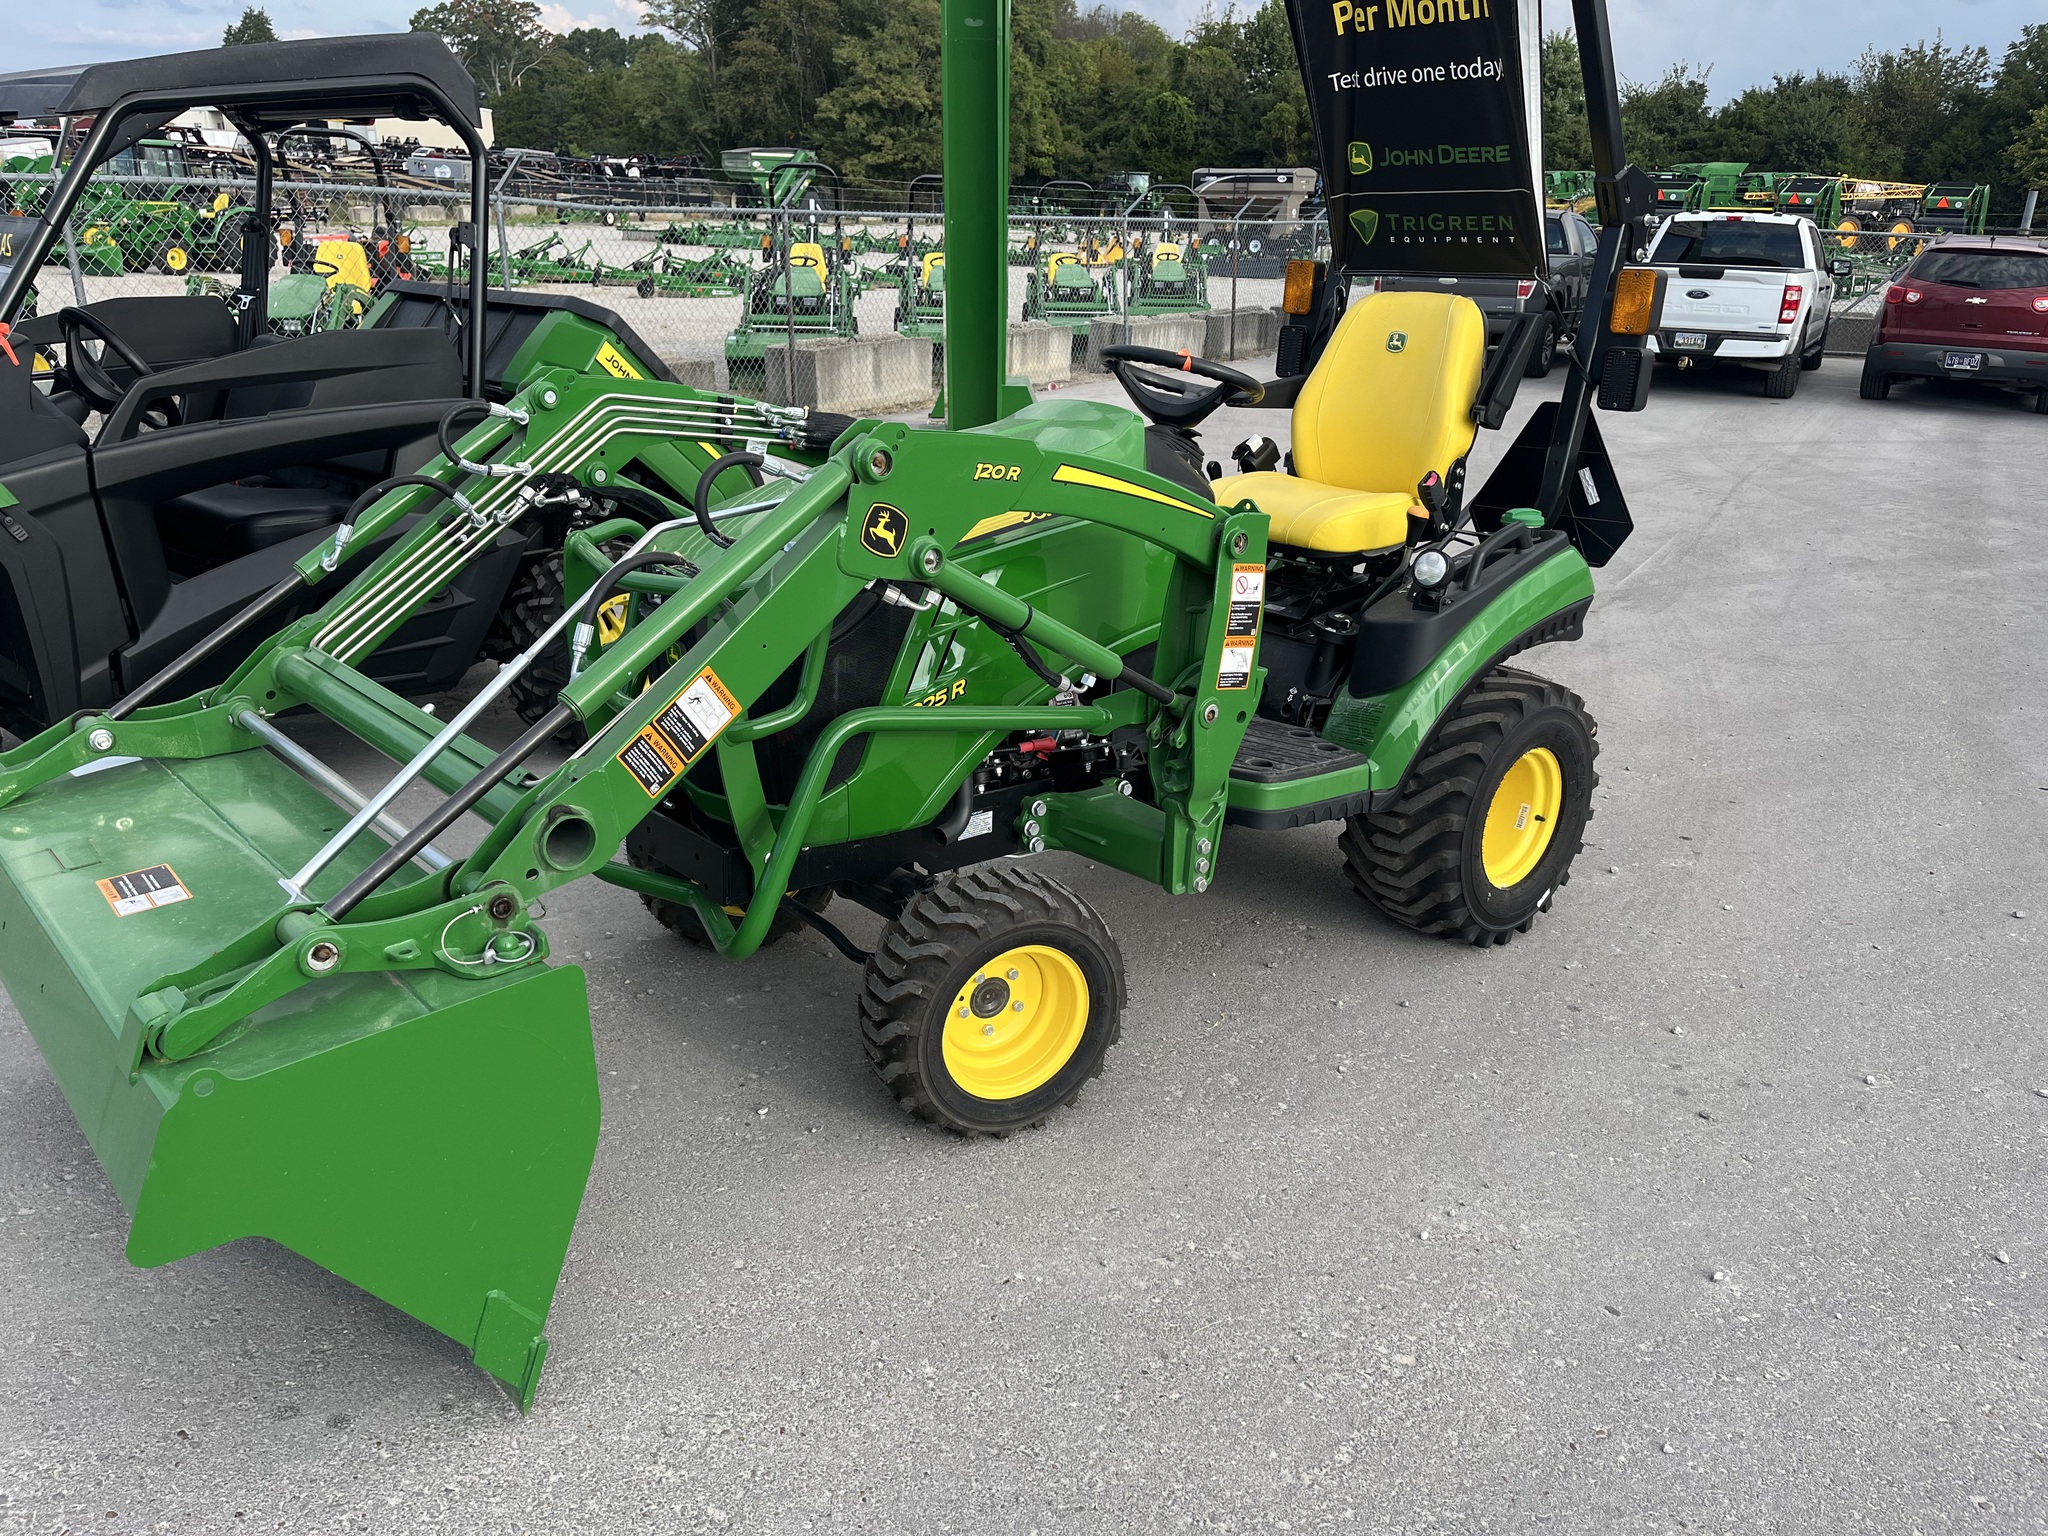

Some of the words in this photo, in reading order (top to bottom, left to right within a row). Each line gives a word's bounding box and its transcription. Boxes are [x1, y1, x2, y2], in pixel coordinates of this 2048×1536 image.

[1332, 0, 1378, 36] Per
[1328, 71, 1361, 92] Test
[1364, 66, 1407, 88] drive
[1411, 66, 1446, 83] one
[1379, 147, 1434, 167] JOHN
[1437, 144, 1511, 165] DEERE
[1239, 565, 1264, 573] WARNING
[711, 680, 736, 710] WARNING
[653, 739, 679, 769] WARNING
